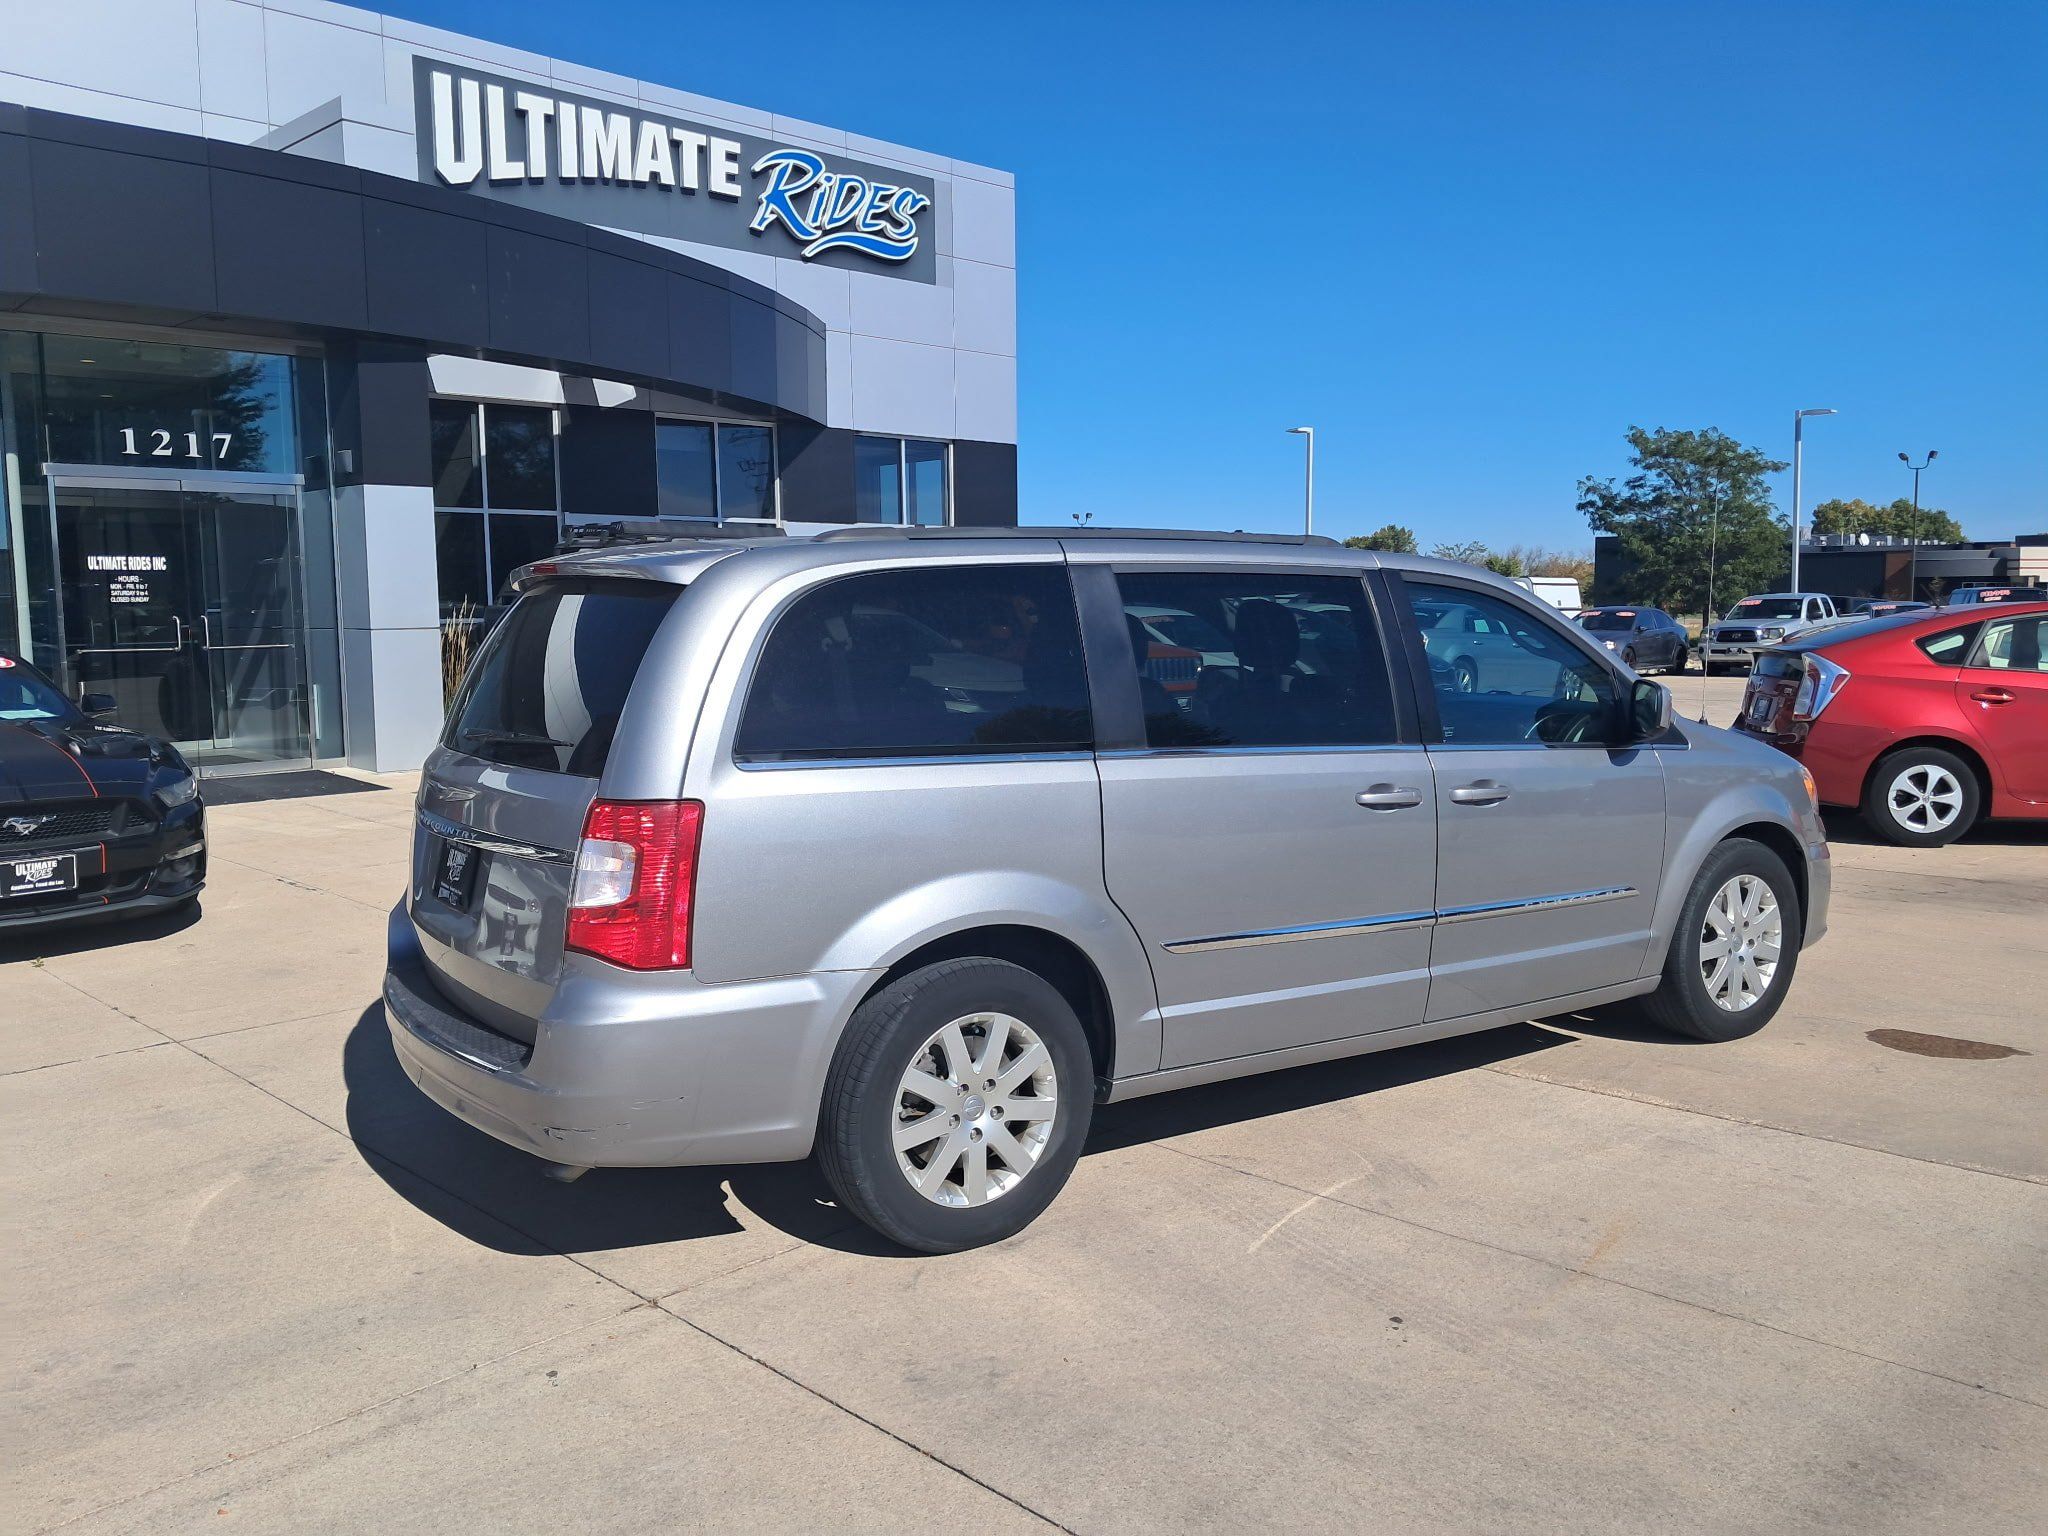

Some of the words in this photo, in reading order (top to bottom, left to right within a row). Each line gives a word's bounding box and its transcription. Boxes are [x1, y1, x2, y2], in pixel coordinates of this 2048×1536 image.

[430, 70, 742, 198] ULTIMATE
[119, 427, 232, 459] 1217
[87, 555, 127, 571] ULTIMATE
[128, 556, 151, 571] RIDES
[152, 556, 167, 571] INC
[117, 575, 139, 583] HOURS
[15, 860, 57, 877] ULTIMATE
